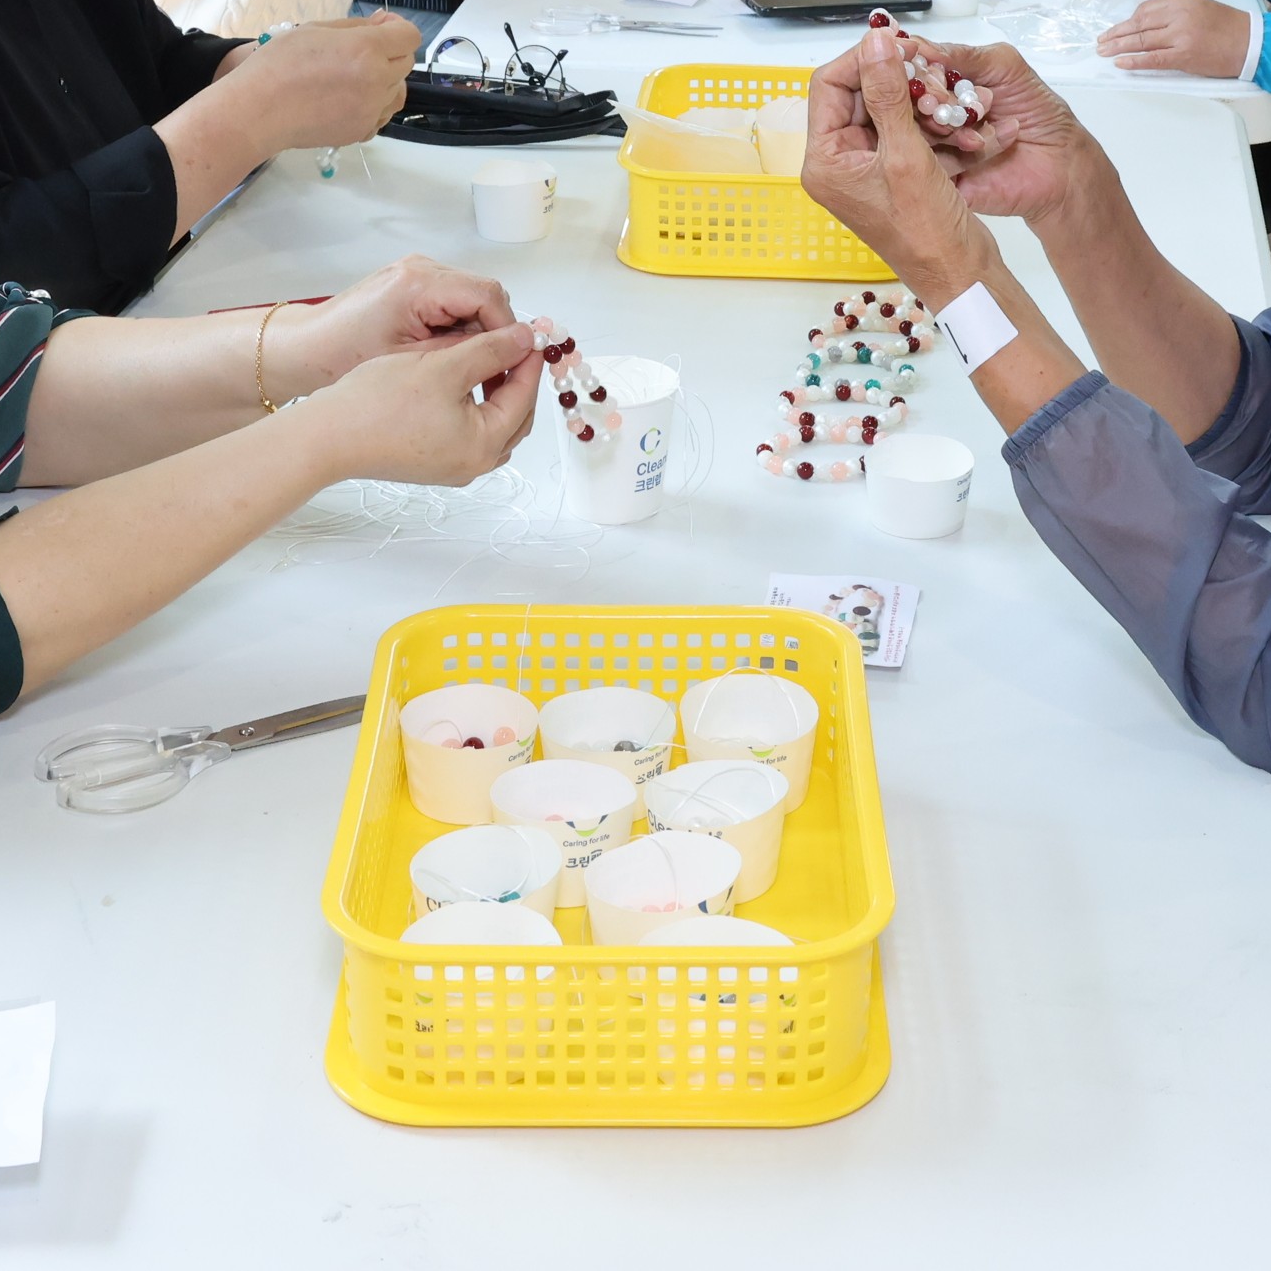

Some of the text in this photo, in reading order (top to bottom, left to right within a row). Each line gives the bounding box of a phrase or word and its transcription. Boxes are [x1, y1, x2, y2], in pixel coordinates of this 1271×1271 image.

[634, 471, 662, 493] 크린랩
[634, 754, 655, 766] Caring
[776, 755, 788, 763] life
[562, 833, 611, 848] Caring for life
